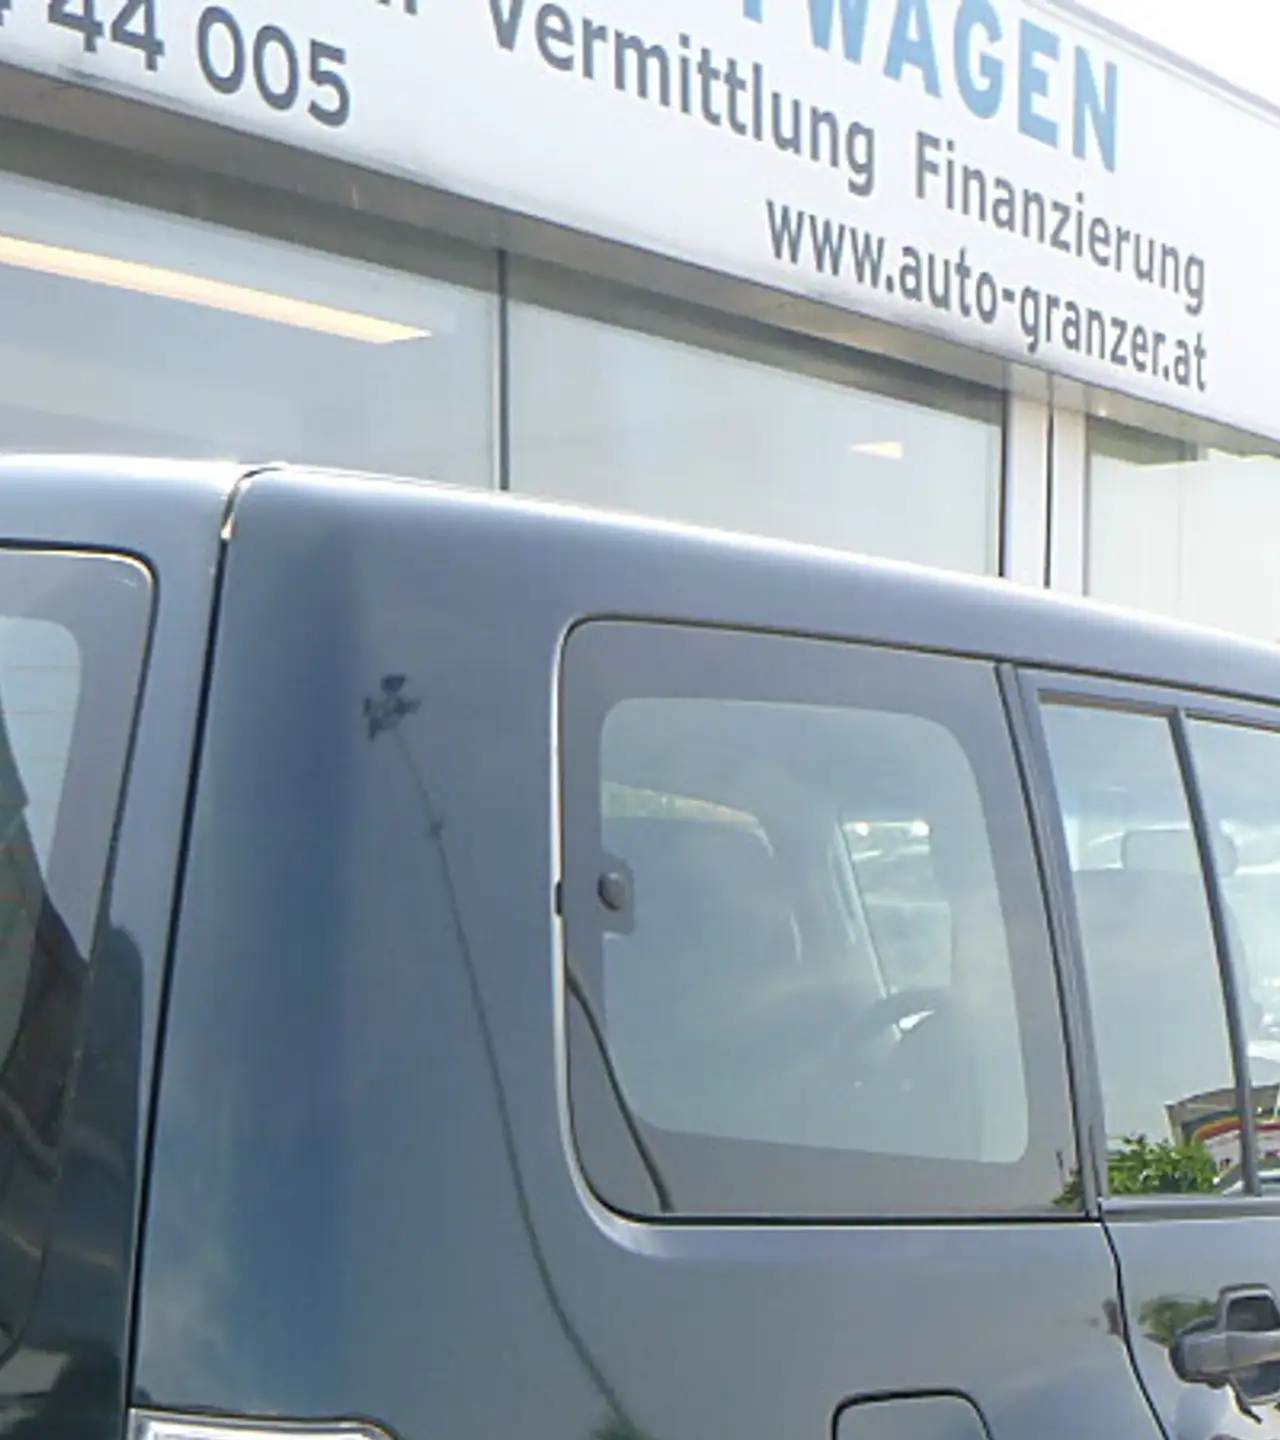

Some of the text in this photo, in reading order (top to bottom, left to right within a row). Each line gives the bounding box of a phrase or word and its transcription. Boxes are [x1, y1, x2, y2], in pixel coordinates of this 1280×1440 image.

[197, 5, 352, 127] 005
[487, 0, 1207, 315] Vermittlung Finanzierung
[742, 0, 1120, 173] WAGEN
[765, 198, 1208, 392] www.auto-granzer.at
